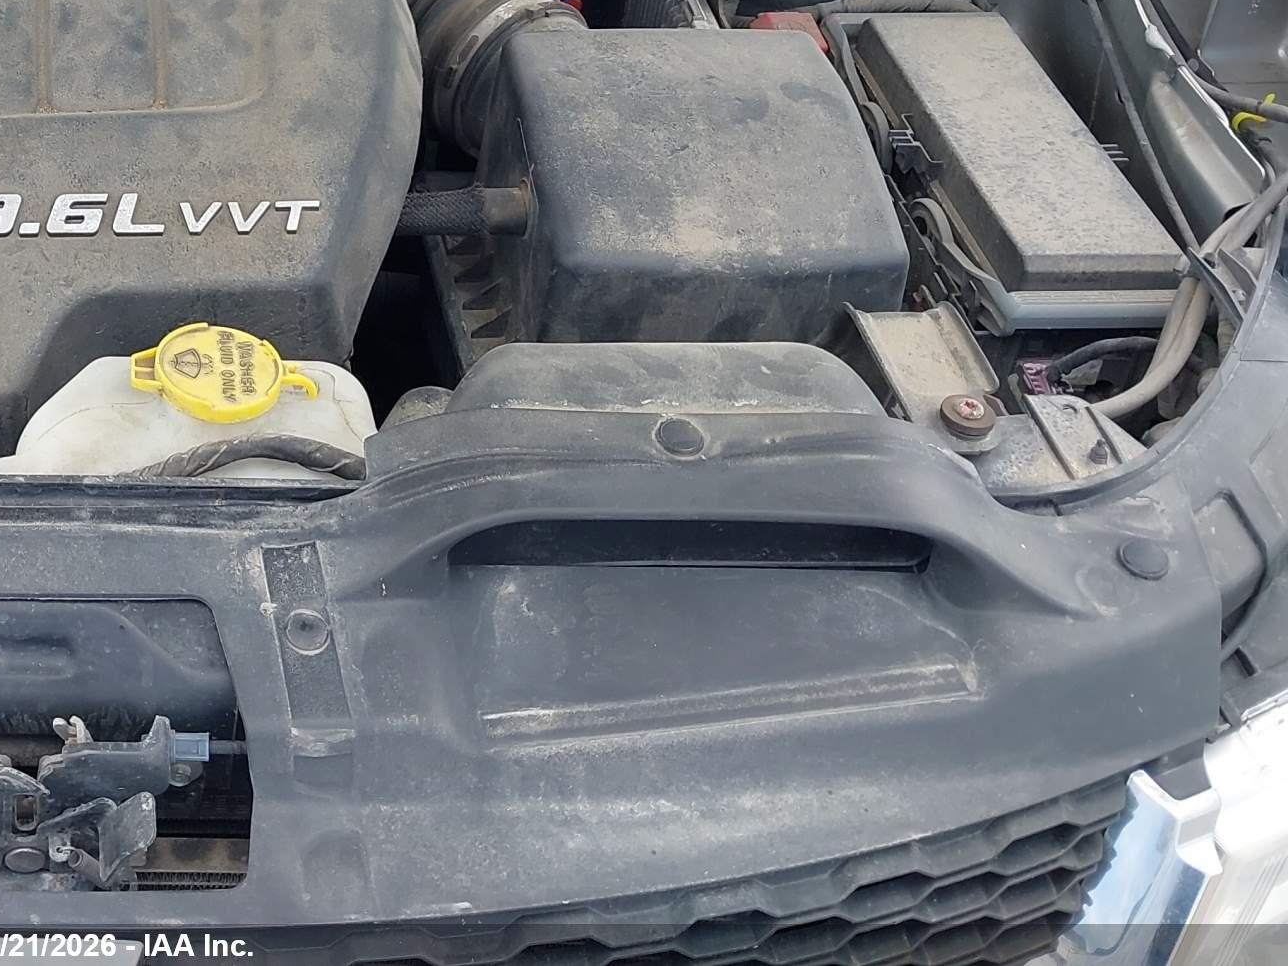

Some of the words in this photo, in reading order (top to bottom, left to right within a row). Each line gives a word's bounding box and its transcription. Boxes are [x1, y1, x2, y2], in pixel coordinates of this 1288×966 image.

[178, 199, 322, 235] VVT
[217, 330, 233, 365] FLUID
[236, 340, 255, 395] WASHER
[221, 369, 236, 402] ONLY
